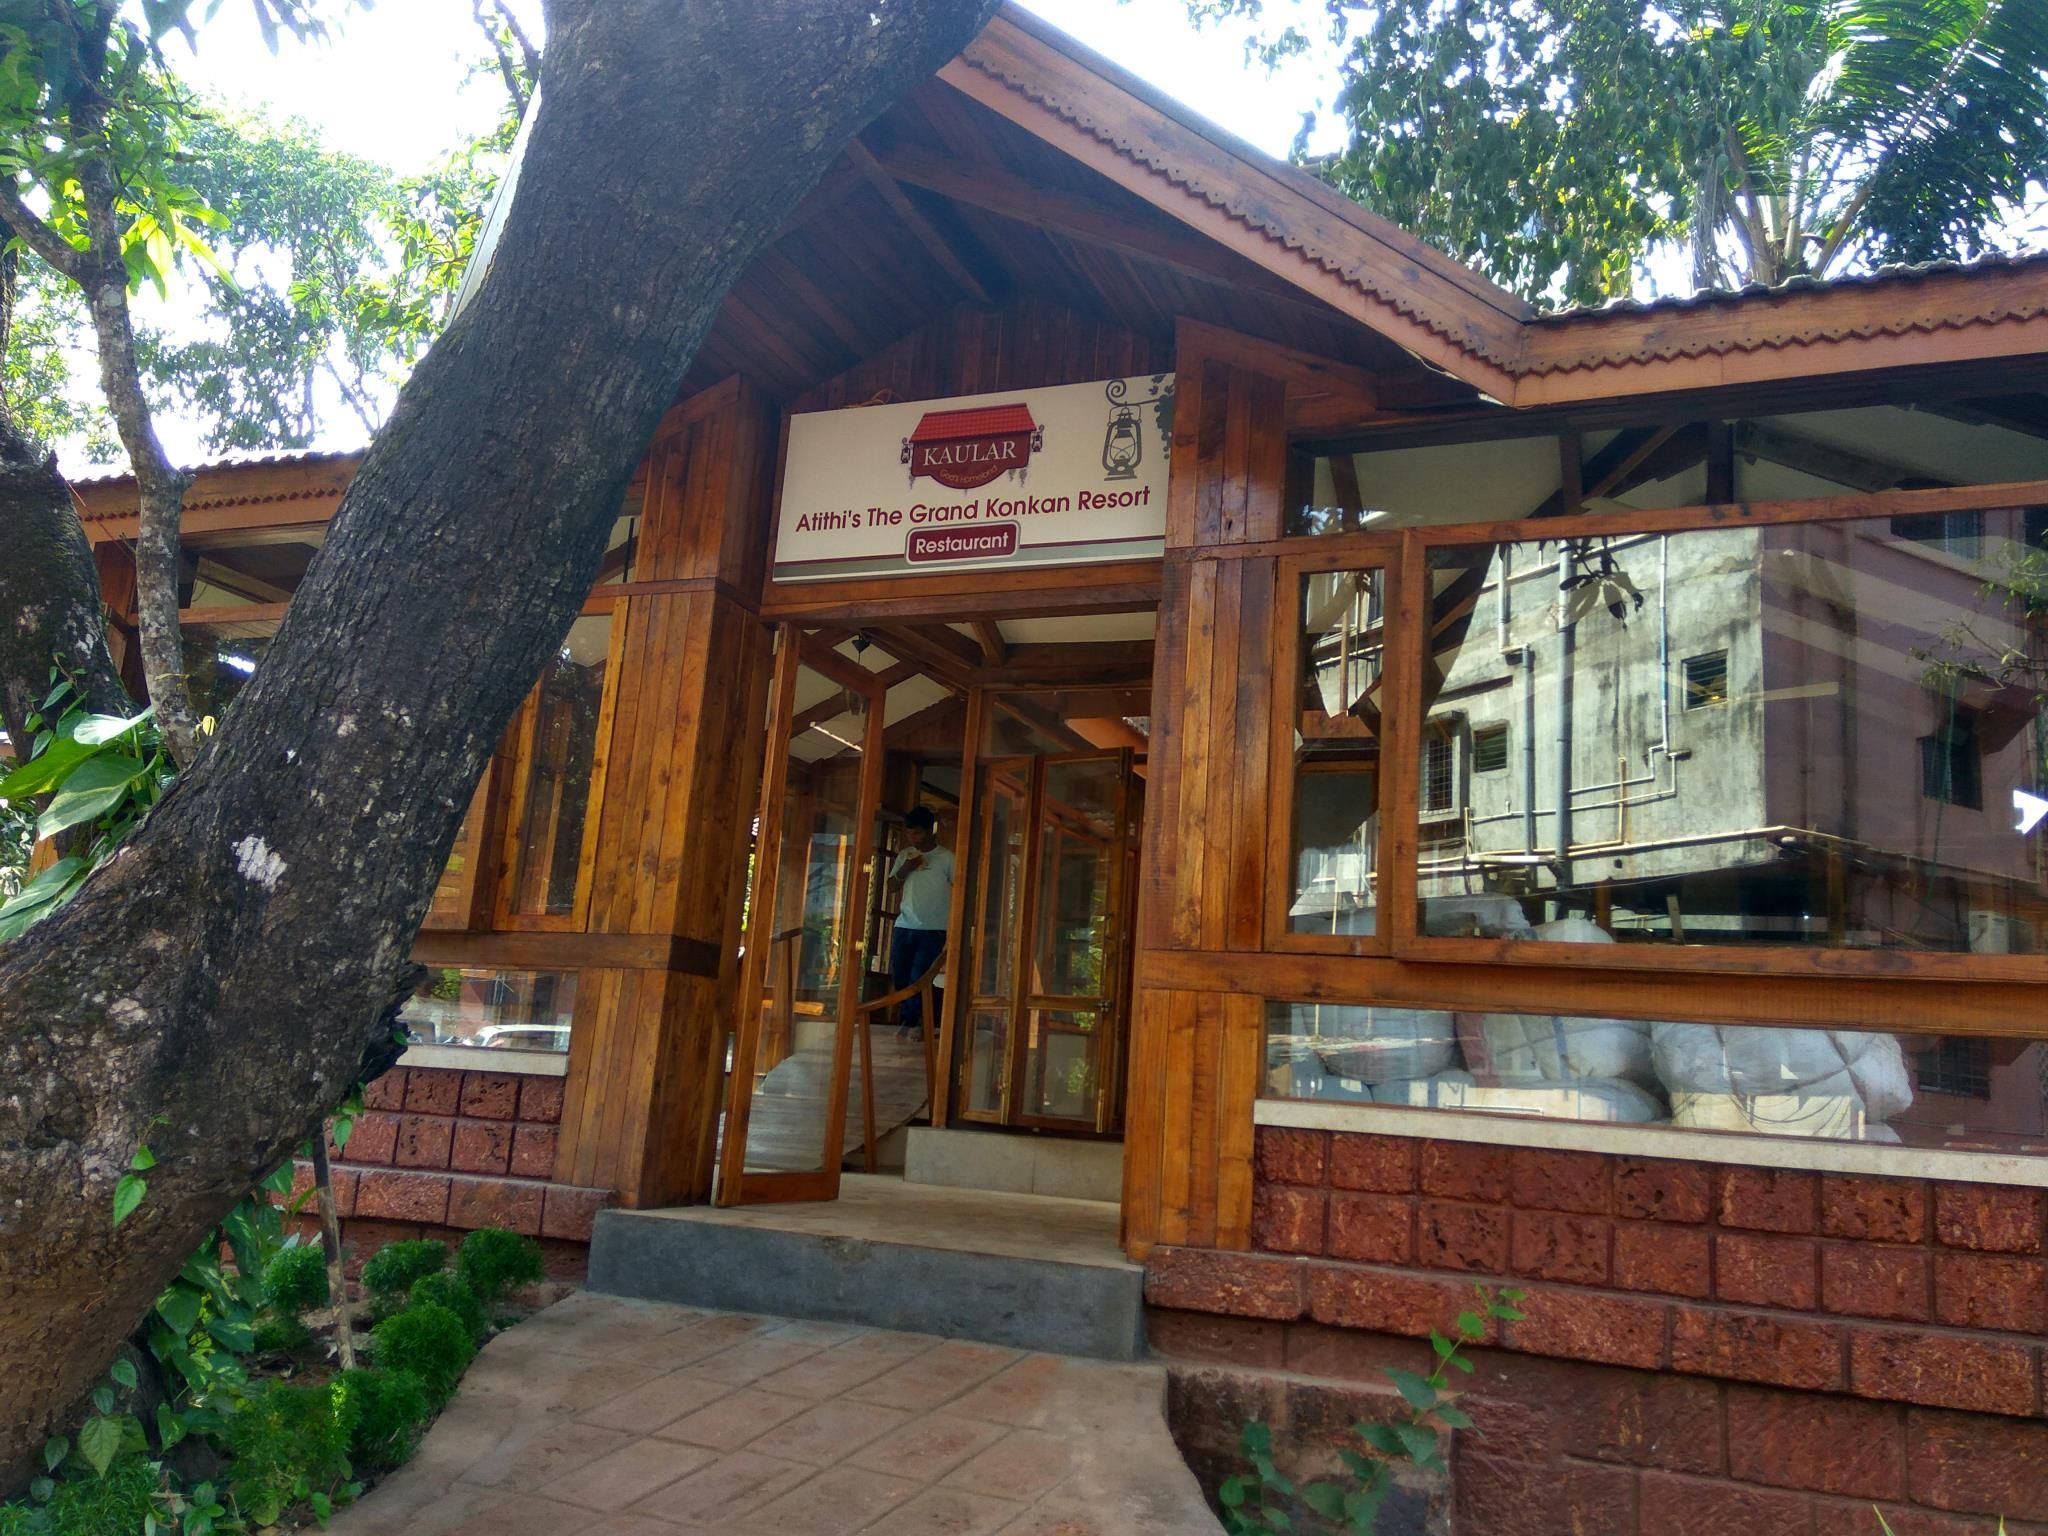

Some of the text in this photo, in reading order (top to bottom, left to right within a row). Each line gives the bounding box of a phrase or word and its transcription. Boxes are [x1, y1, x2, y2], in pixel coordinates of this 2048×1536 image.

[923, 440, 1017, 466] KAULAR
[796, 485, 1151, 533] Atithi's The Grand Konkan Resort
[915, 531, 1009, 555] Restaurant
